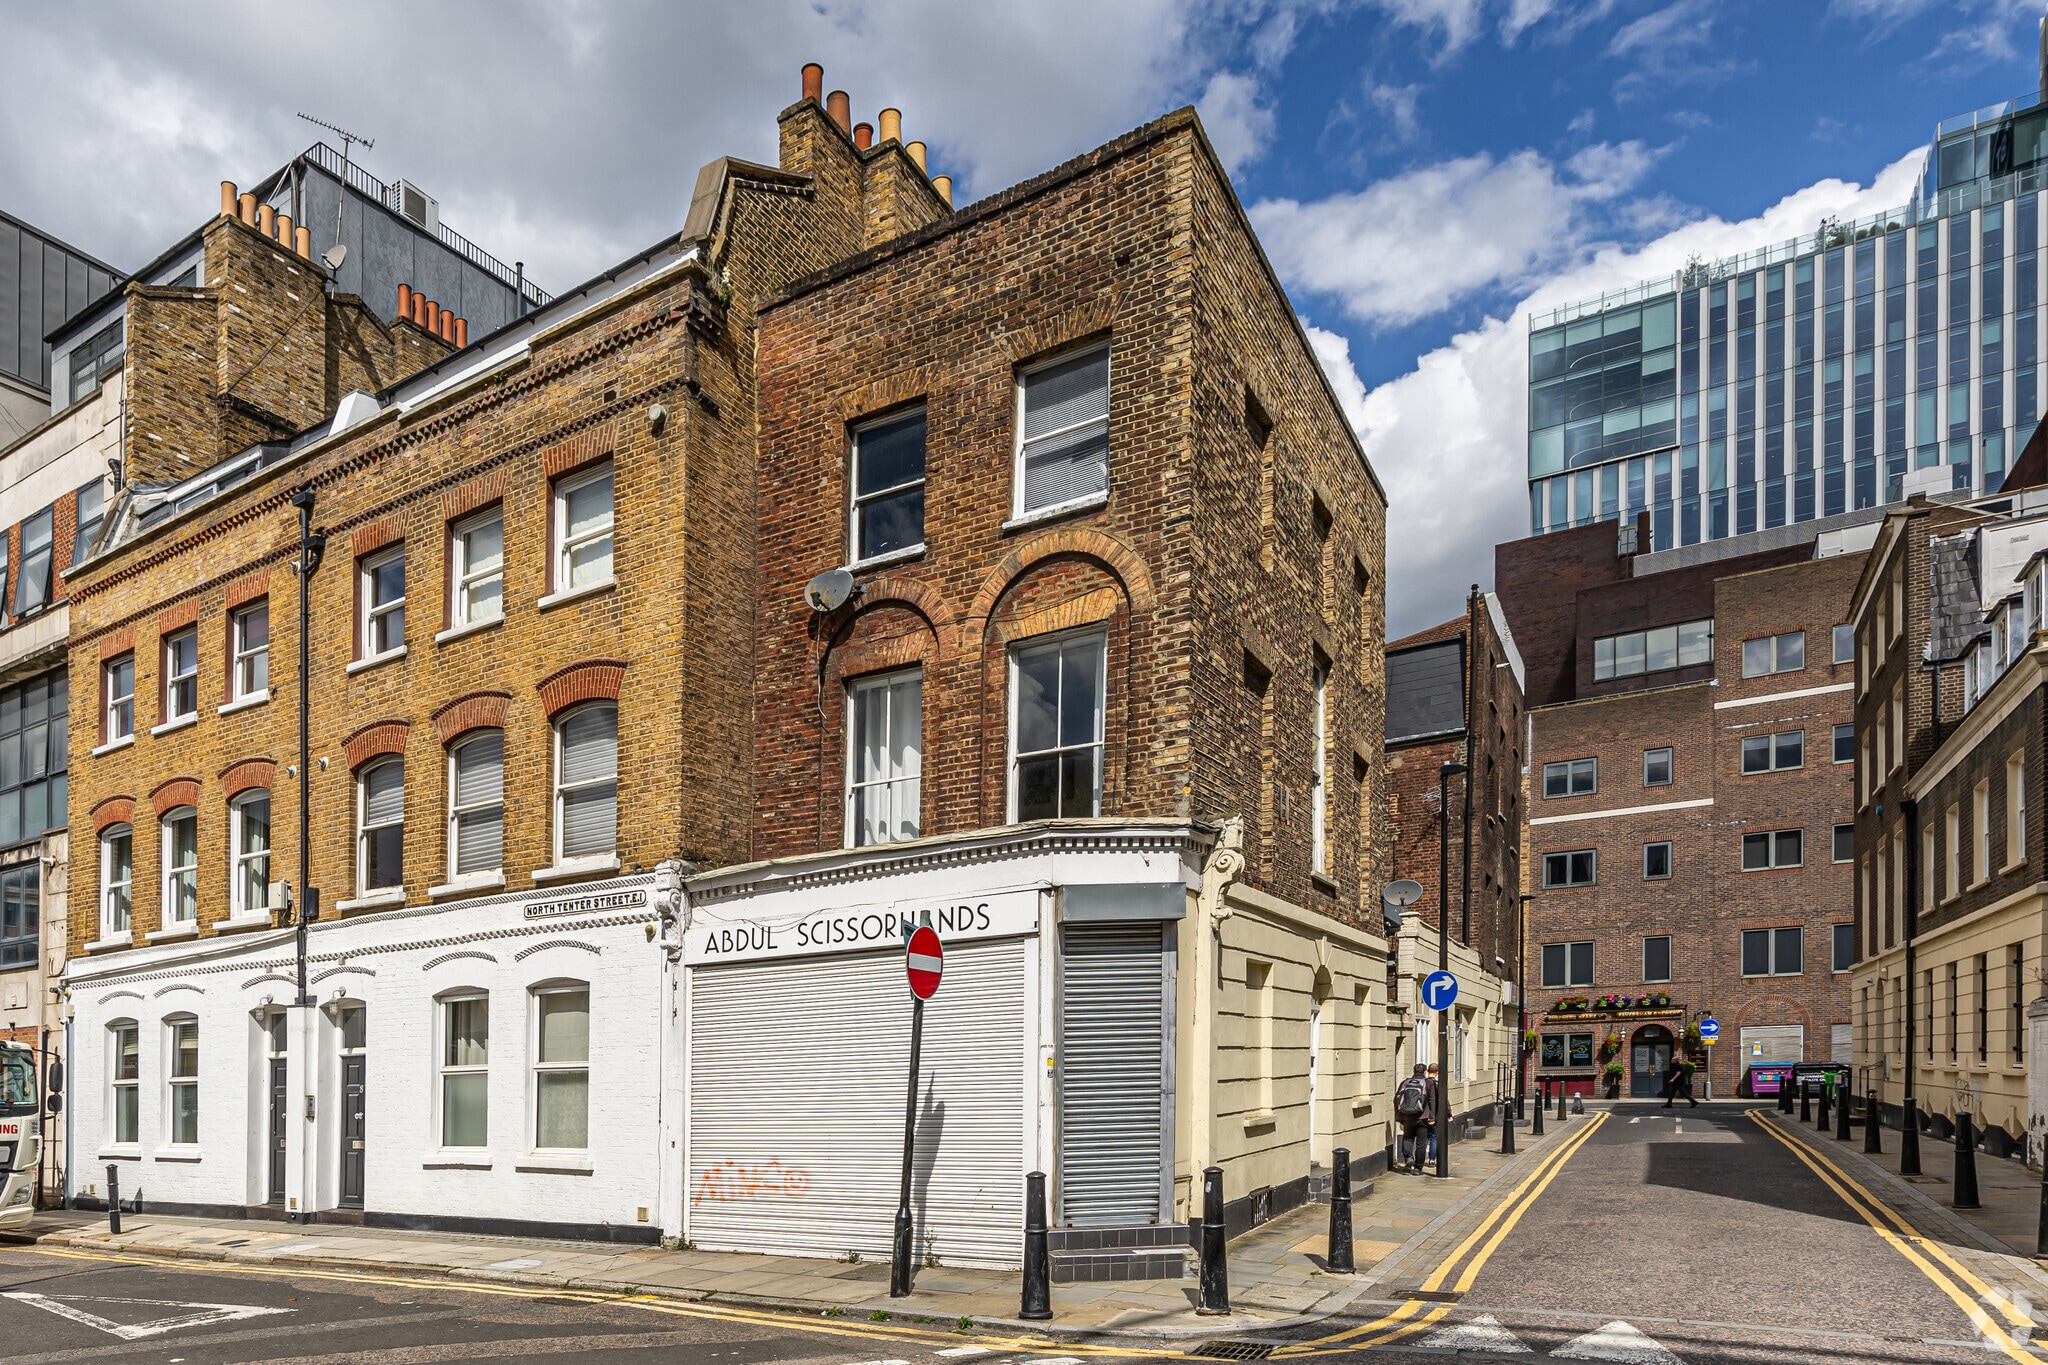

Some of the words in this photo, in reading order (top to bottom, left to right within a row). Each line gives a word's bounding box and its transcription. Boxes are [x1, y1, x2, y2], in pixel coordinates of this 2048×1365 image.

[527, 904, 555, 916] NORTH
[557, 900, 591, 912] TENTER
[704, 926, 778, 955] ABDUL
[797, 903, 990, 947] SCISSORHNDS
